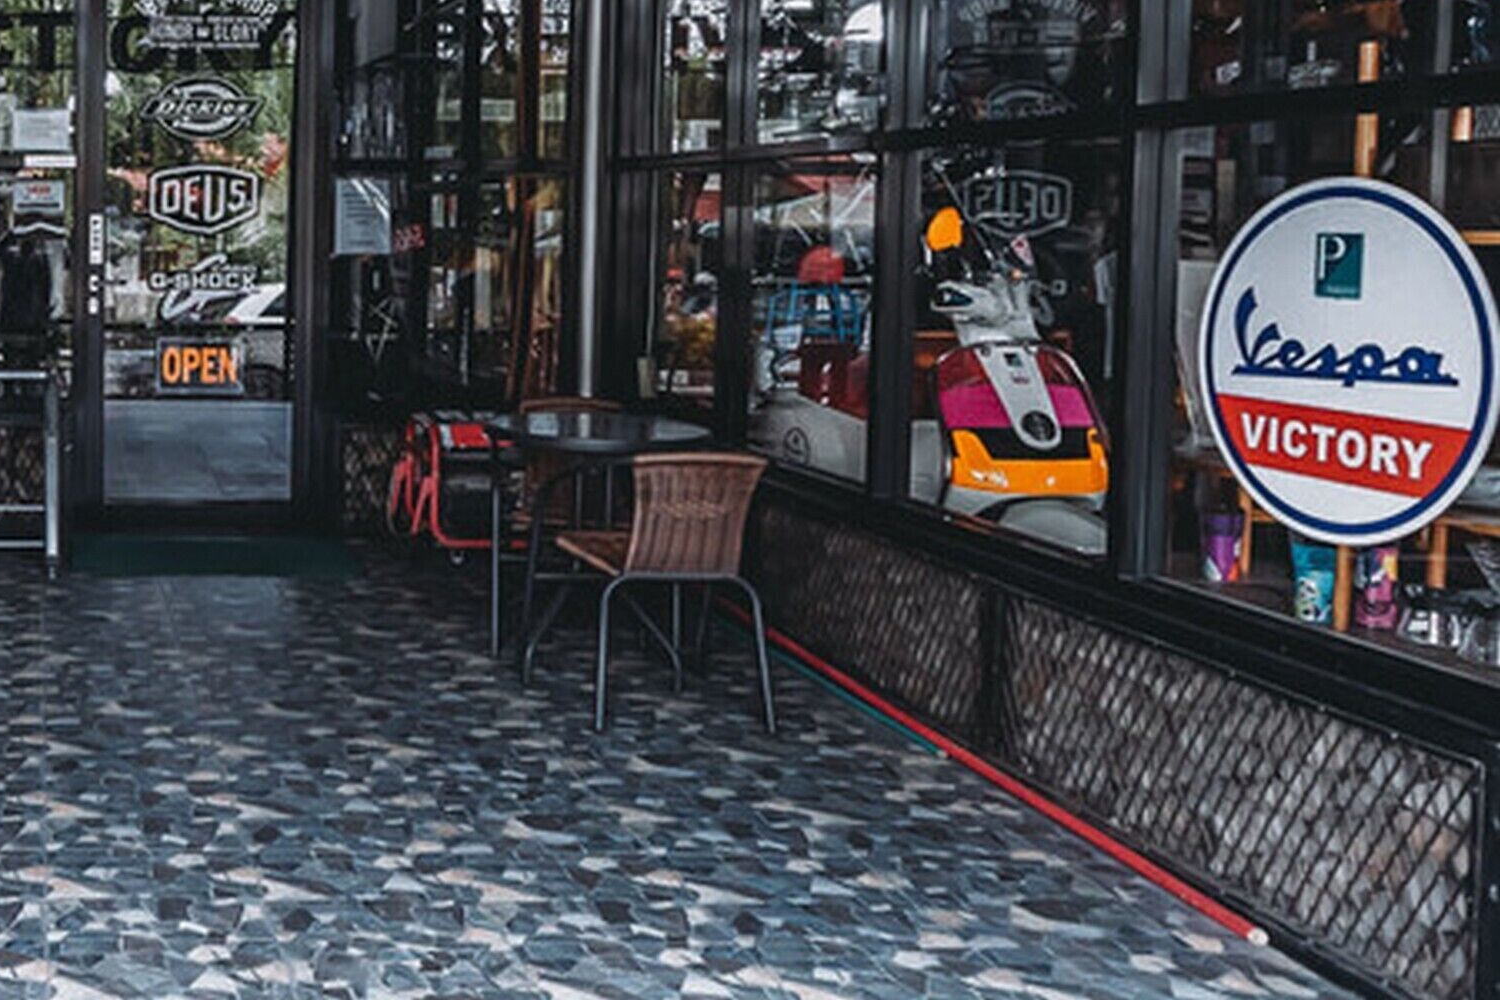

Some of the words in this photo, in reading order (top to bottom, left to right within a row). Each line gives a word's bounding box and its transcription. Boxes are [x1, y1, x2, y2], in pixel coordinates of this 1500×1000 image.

[161, 174, 247, 222] DEUS
[150, 272, 257, 290] G-SHOCK
[1231, 286, 1459, 388] Vespa
[162, 345, 238, 384] OPEN
[1240, 412, 1433, 481] VICTORY
